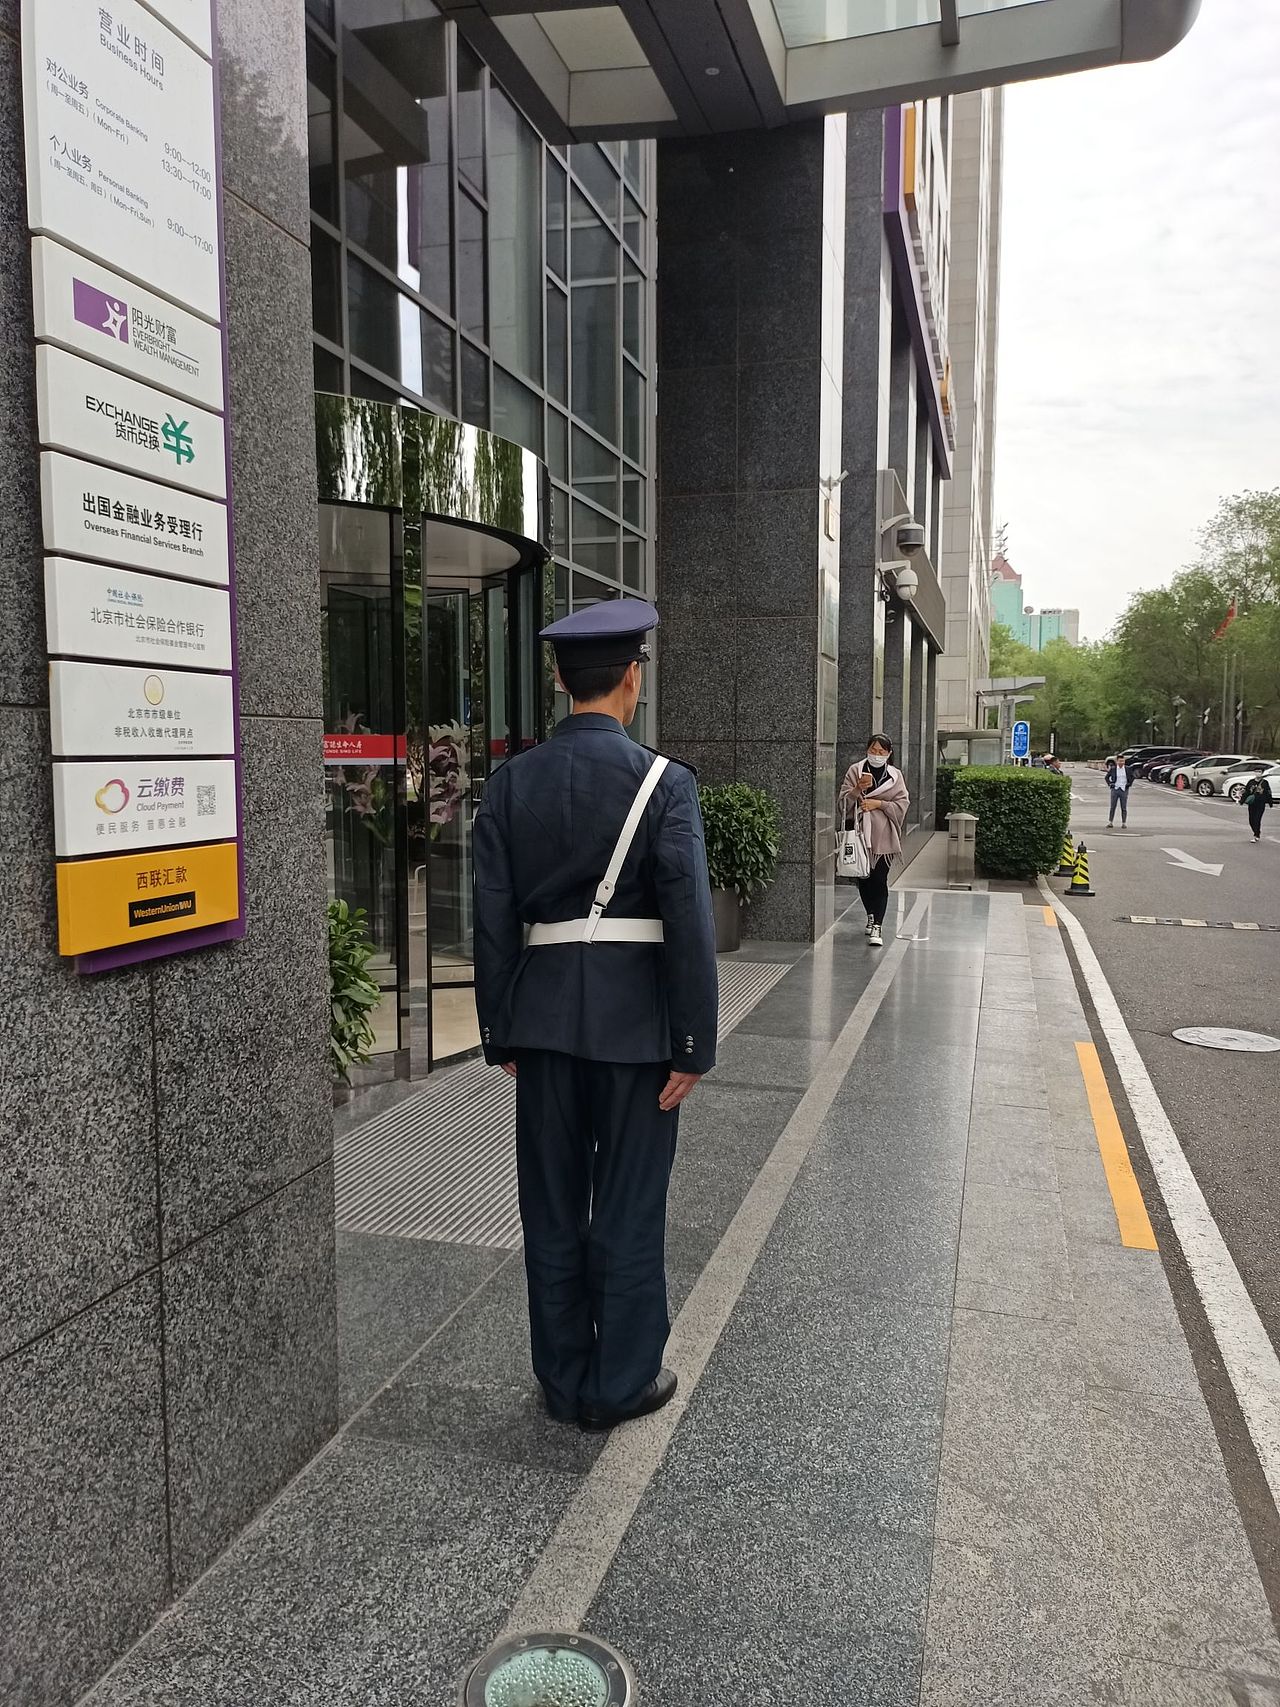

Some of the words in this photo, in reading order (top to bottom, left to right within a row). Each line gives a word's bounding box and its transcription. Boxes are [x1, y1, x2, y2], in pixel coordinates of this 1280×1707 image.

[98, 7, 164, 77] 营业时间
[46, 57, 88, 99] 对公业务
[99, 33, 138, 71] Business
[139, 63, 164, 91] Hours
[95, 98, 124, 125] Corporate
[125, 119, 148, 142] Banking
[49, 134, 92, 173] 个人业务
[98, 170, 125, 193] Personal
[125, 187, 149, 210] Banking
[132, 307, 177, 346] 阳光财富
[132, 327, 171, 352] EVERBRIGHT
[133, 338, 159, 359] WEALTH
[158, 350, 200, 377] MANAGEMENT
[85, 395, 159, 435] EXCHANGE
[114, 421, 161, 453] 货币兑换
[82, 492, 204, 542] 出国金融业务受理行
[84, 519, 119, 537] Overseas
[120, 529, 152, 546] Financial
[153, 536, 181, 552] Services
[182, 543, 204, 557] Branch
[90, 607, 205, 638] 北京市社会保险合作银行
[114, 726, 194, 739] 非税收入收缴代理网点
[128, 707, 181, 720] 北京市市级单位
[136, 776, 185, 798] 云缴费
[136, 801, 156, 812] Cloud
[157, 800, 185, 811] Payment
[136, 865, 188, 890] 西联汇款
